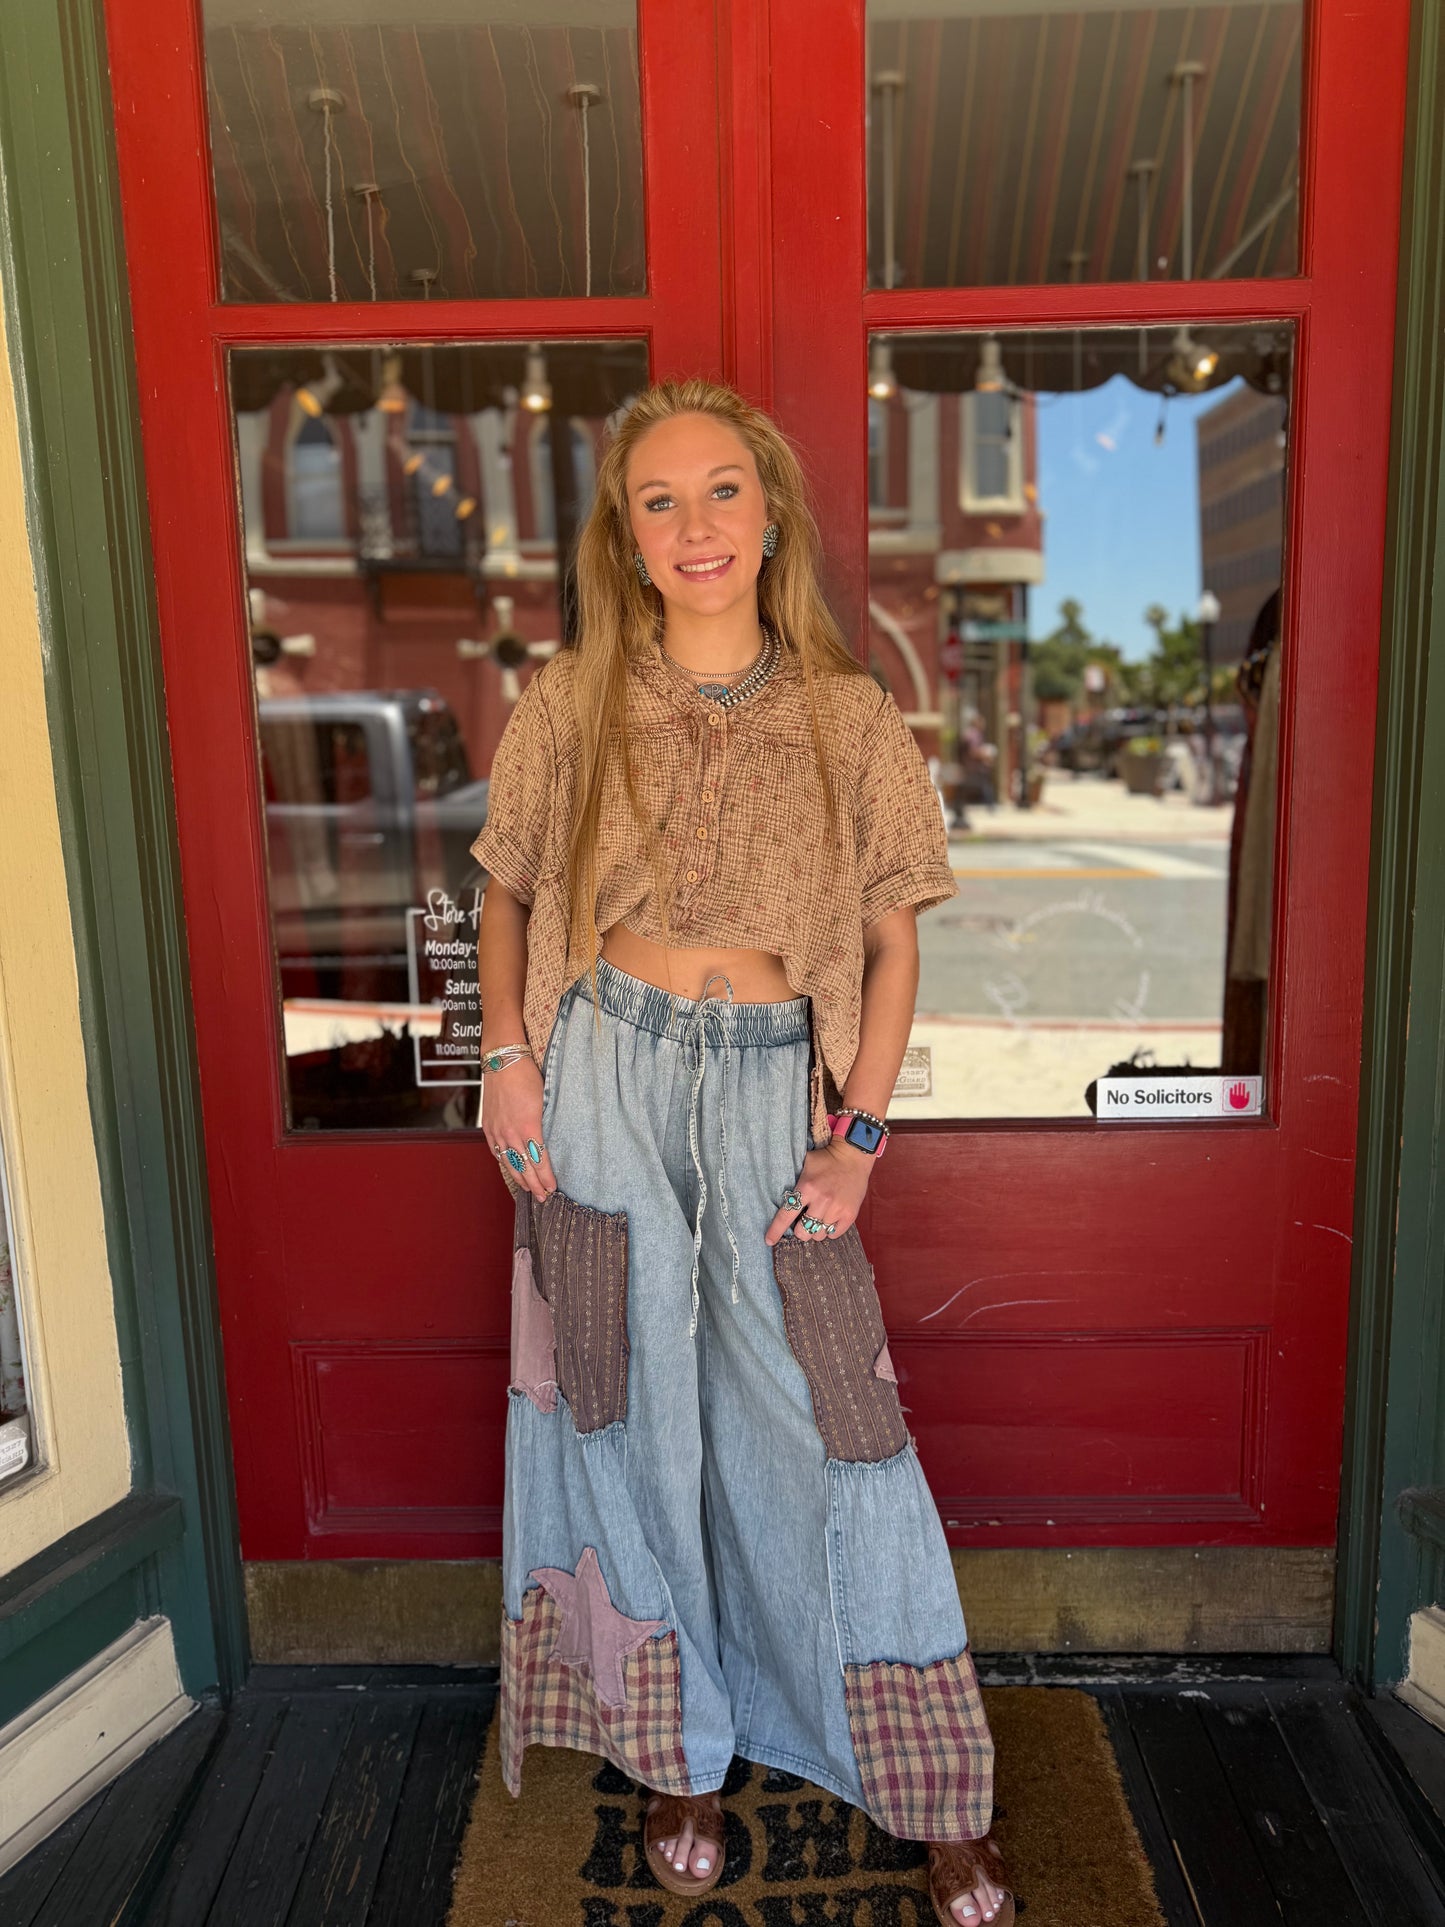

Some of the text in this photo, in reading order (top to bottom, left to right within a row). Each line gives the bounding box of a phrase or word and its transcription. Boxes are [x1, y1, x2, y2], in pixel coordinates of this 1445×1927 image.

[424, 888, 466, 931] Store
[425, 939, 480, 958] Monday-
[468, 959, 477, 969] to
[468, 999, 477, 1010] to
[470, 1043, 480, 1055] to
[1107, 1088, 1213, 1105] No Solicitors
